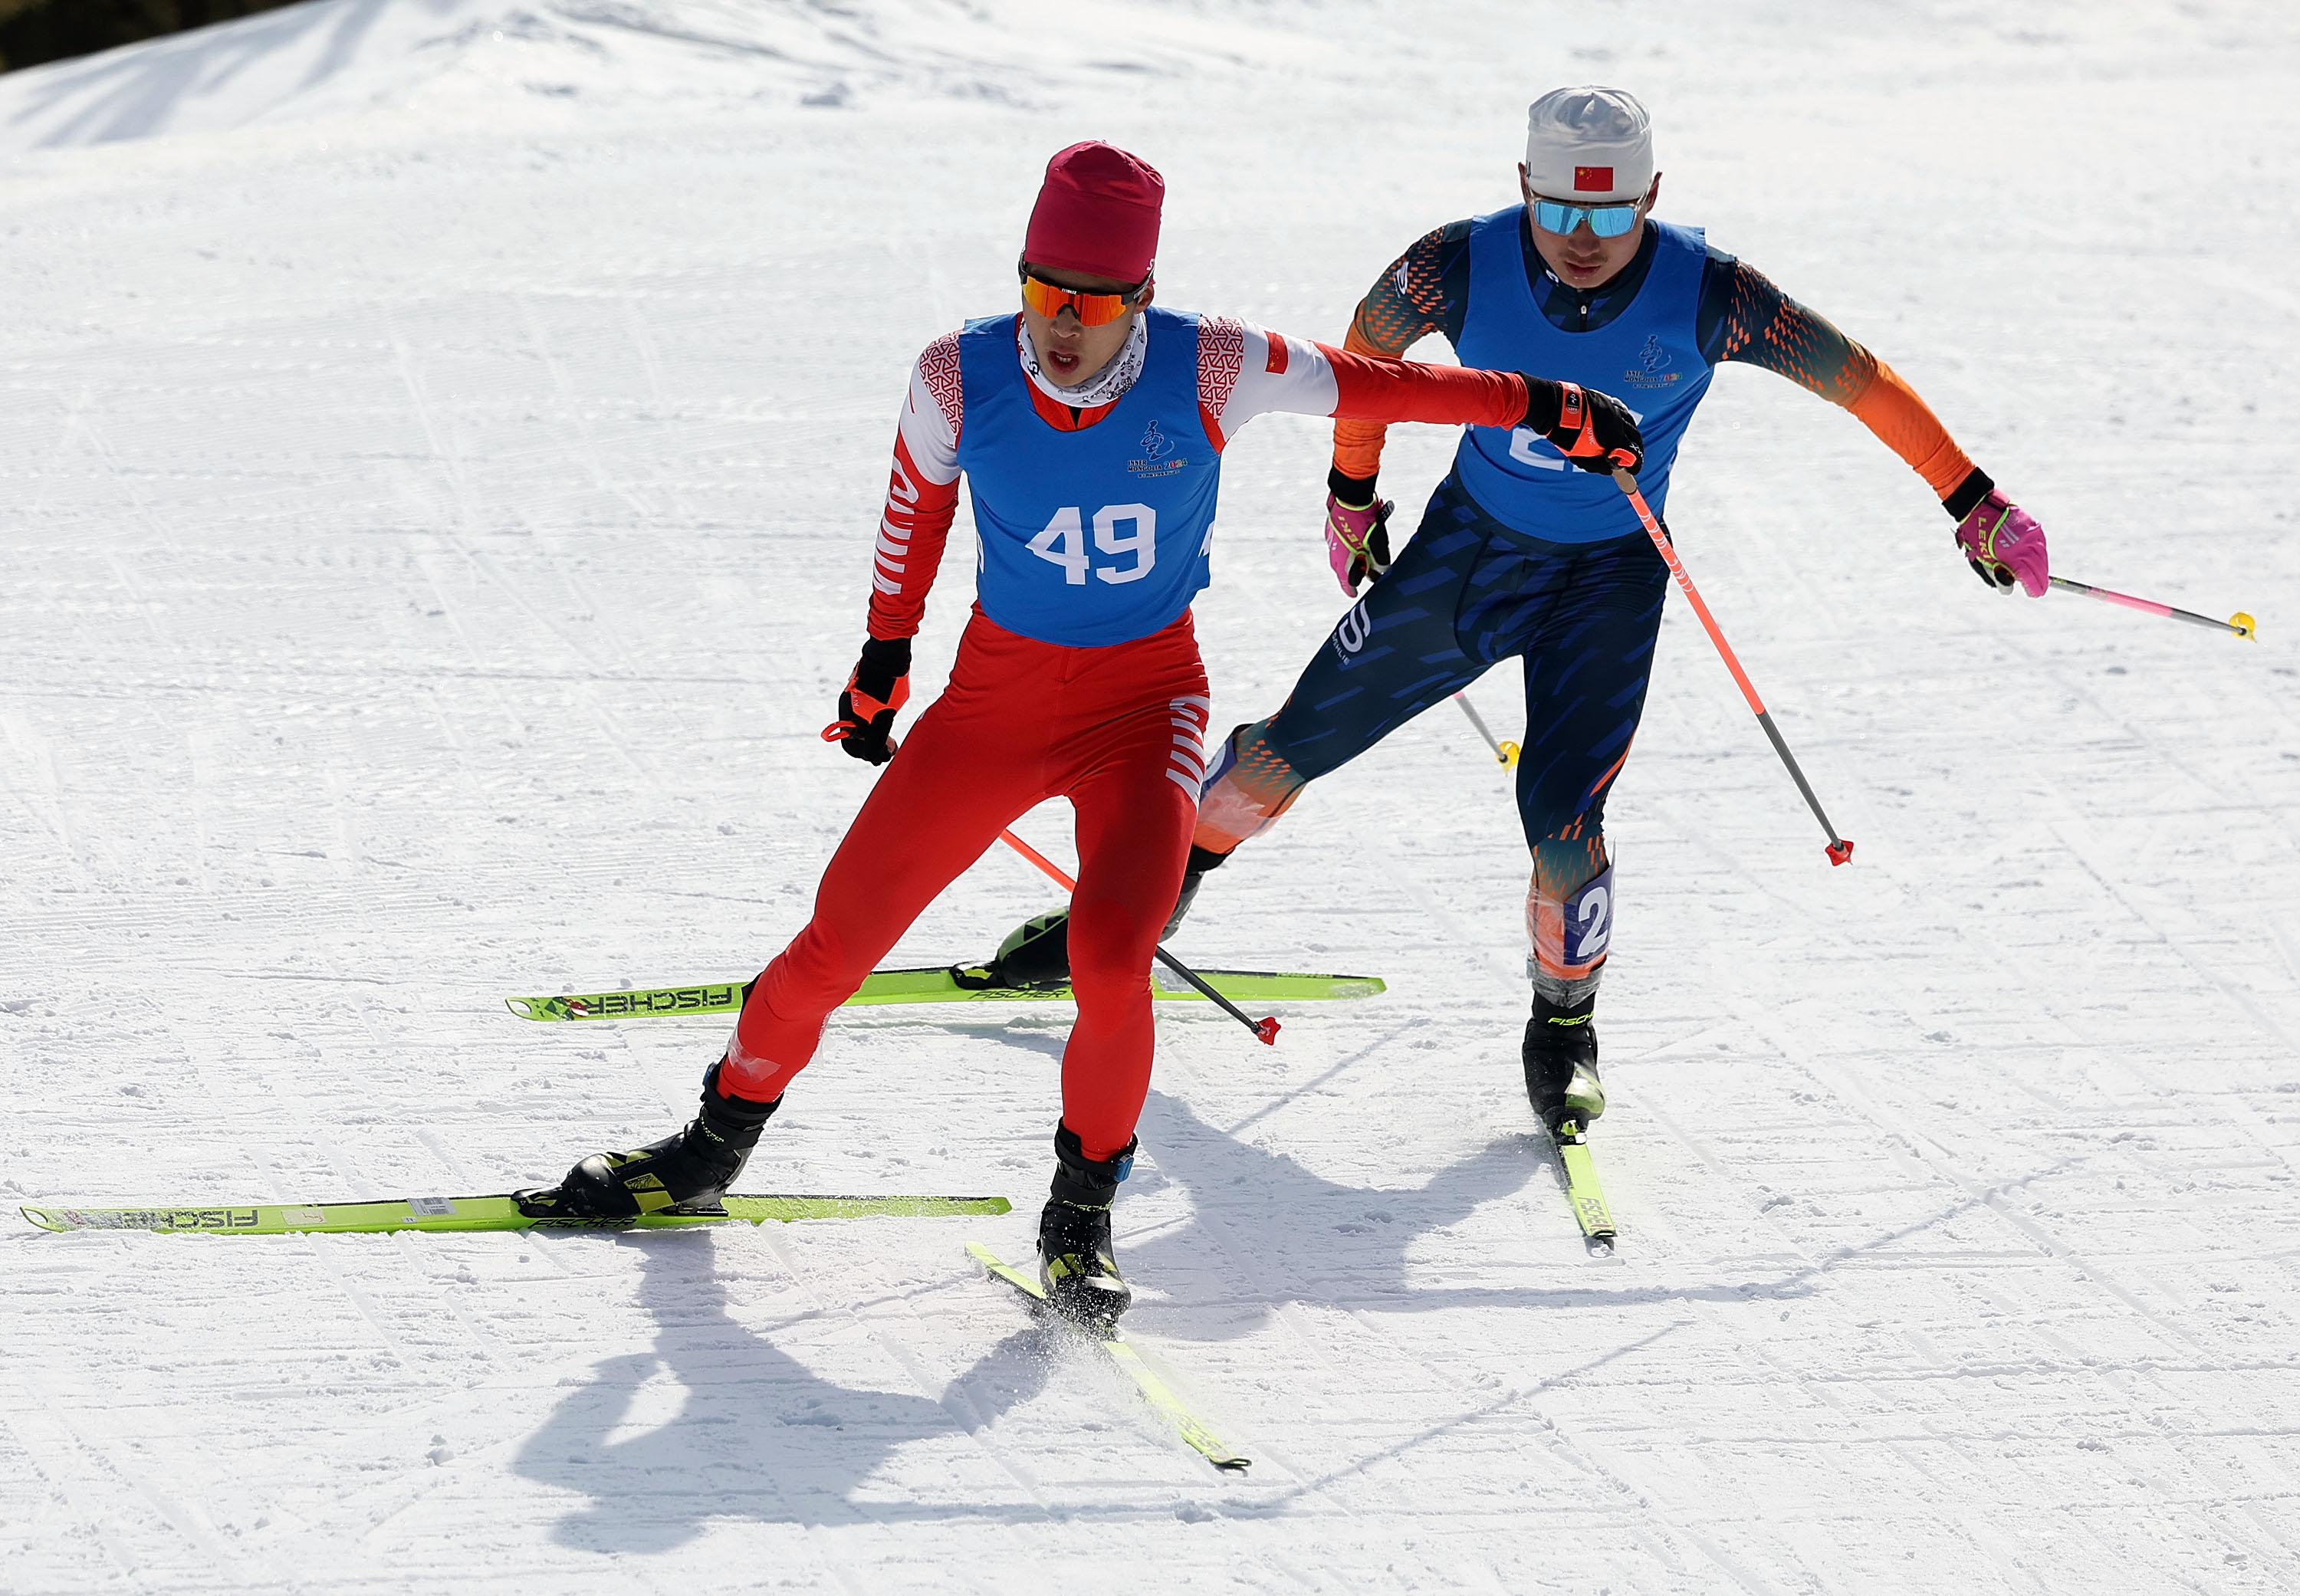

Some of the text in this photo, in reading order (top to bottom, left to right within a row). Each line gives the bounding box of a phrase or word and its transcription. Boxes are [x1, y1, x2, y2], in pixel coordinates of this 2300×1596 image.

[1164, 458, 1188, 470] 2024
[1025, 503, 1156, 585] 49
[1978, 516, 1991, 558] LEKI
[1576, 886, 1608, 957] 2
[580, 987, 732, 1015] FISCHER
[968, 990, 1067, 1000] FISCHER
[527, 1218, 638, 1230] FISCHER
